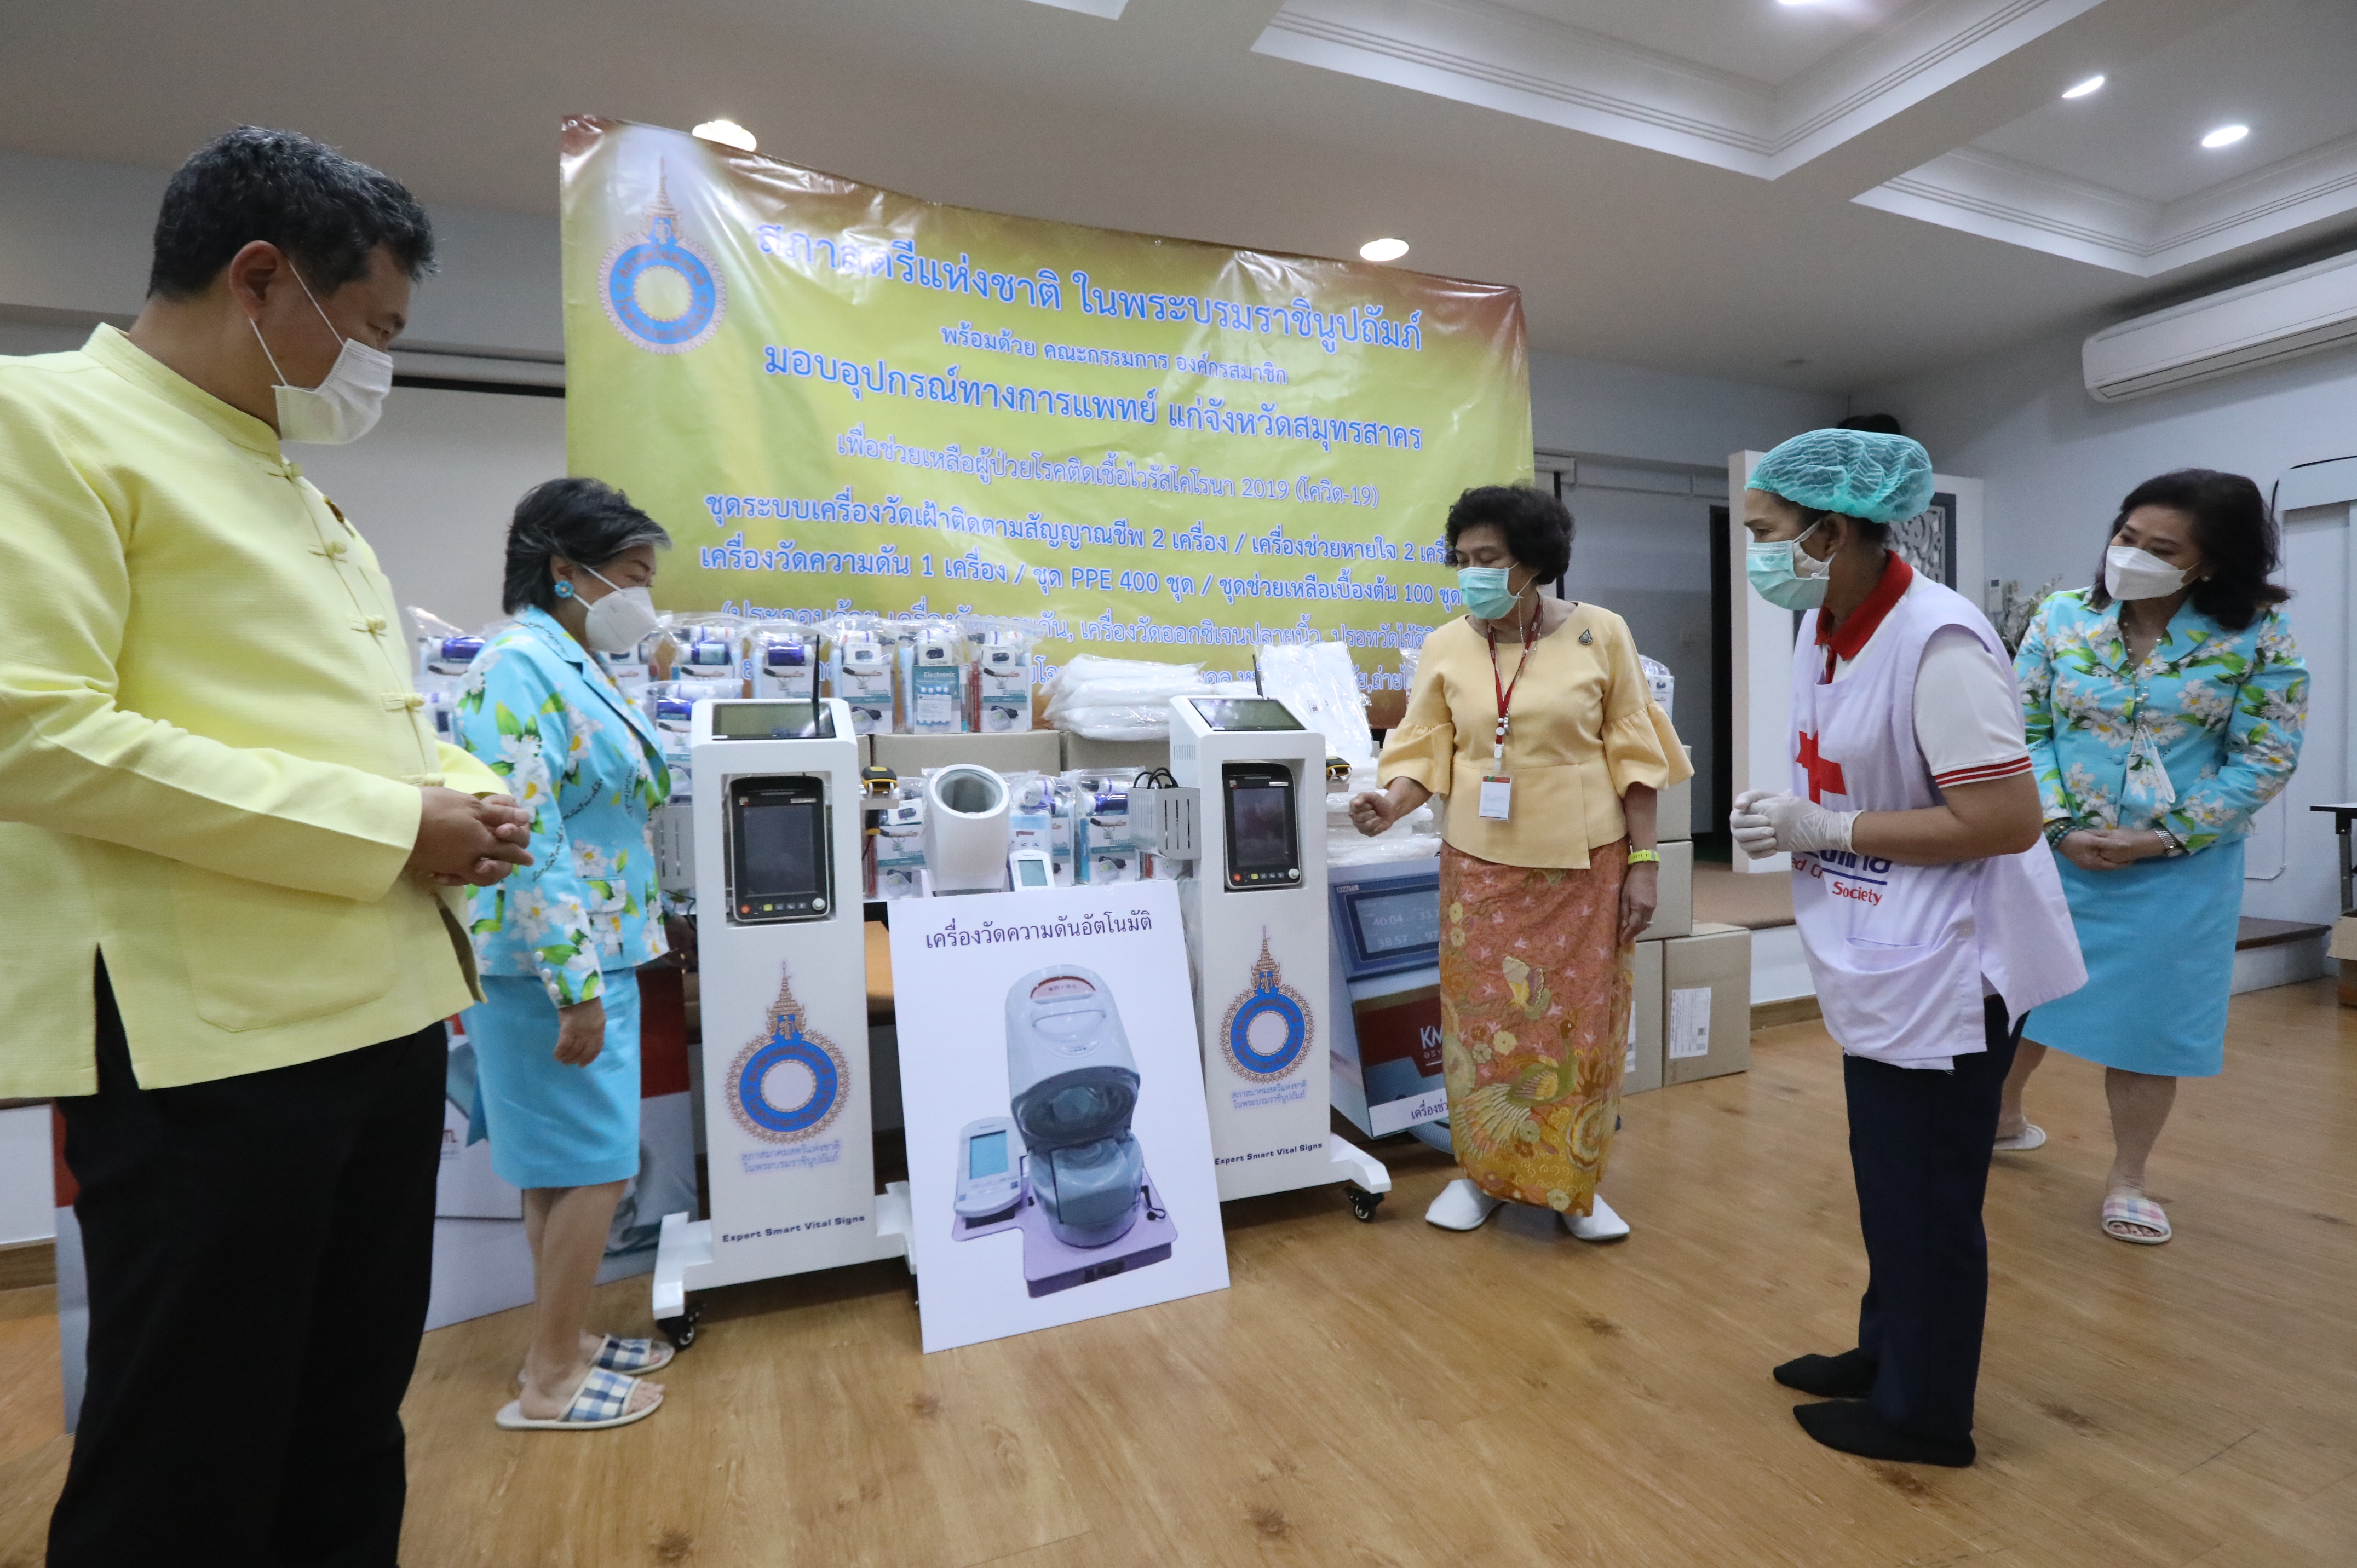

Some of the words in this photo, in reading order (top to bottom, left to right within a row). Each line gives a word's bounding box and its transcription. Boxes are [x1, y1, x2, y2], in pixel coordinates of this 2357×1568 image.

[756, 224, 1062, 311] สภาสตรีแห่งชาติ
[1071, 270, 1423, 353] ในพระบรมราชินูปถัมภ์
[940, 320, 1037, 358] พร้อมด้วย
[1043, 343, 1169, 371] คณะกรรมการ
[1175, 351, 1288, 384] องค์กรสมาชิก
[764, 344, 1158, 425] มอบอุปกรณ์ทางการแพทย์
[1168, 396, 1423, 451] แก่จังหวัดสมุทรสาคร
[837, 423, 1235, 497] เพื่อช่วยเหลือผู้ป่วยโรคติดเชื้อไวรัสโคโรนา
[1241, 477, 1290, 499] 2019
[1295, 475, 1378, 508] (โควิด-19)
[704, 487, 1145, 550] ชุดระบบเครื่องวัดเฝ้าติดตามสัญญาณชีพ
[1151, 528, 1166, 549] 2
[1171, 520, 1228, 553] เครื่อง
[1233, 533, 1246, 554] /
[1251, 524, 1398, 561] เครื่องช่วยหายใจ
[1403, 542, 1415, 561] 2
[1419, 534, 1446, 563] เครื่
[701, 531, 911, 576] เครื่องวัดความดัน
[922, 554, 934, 577] 1
[944, 546, 1008, 583] เครื่อง
[1013, 563, 1026, 585] /
[1032, 567, 1063, 595] ชุด
[1071, 567, 1113, 591] PPE
[1119, 570, 1160, 593] 400
[1165, 575, 1195, 602] ชุด
[1200, 574, 1214, 596] /
[1218, 568, 1398, 604] ชุดช่วยเหลือเบื้องต้น
[1404, 583, 1435, 603] 100
[1438, 588, 1462, 613] ชุด
[1832, 881, 1883, 906] Society
[925, 909, 1153, 949] เครื่องวัดความดันอัตโนมัติ
[1411, 1098, 1449, 1120] เครื่องช่ว
[1214, 1155, 1245, 1166] Expert
[1246, 1151, 1274, 1161] Smart
[1277, 1146, 1297, 1156] Vital
[1299, 1143, 1323, 1152] Signs
[722, 1231, 762, 1242] Expert
[764, 1225, 801, 1236] Smart
[804, 1219, 832, 1230] Vital
[834, 1215, 865, 1226] Signs
